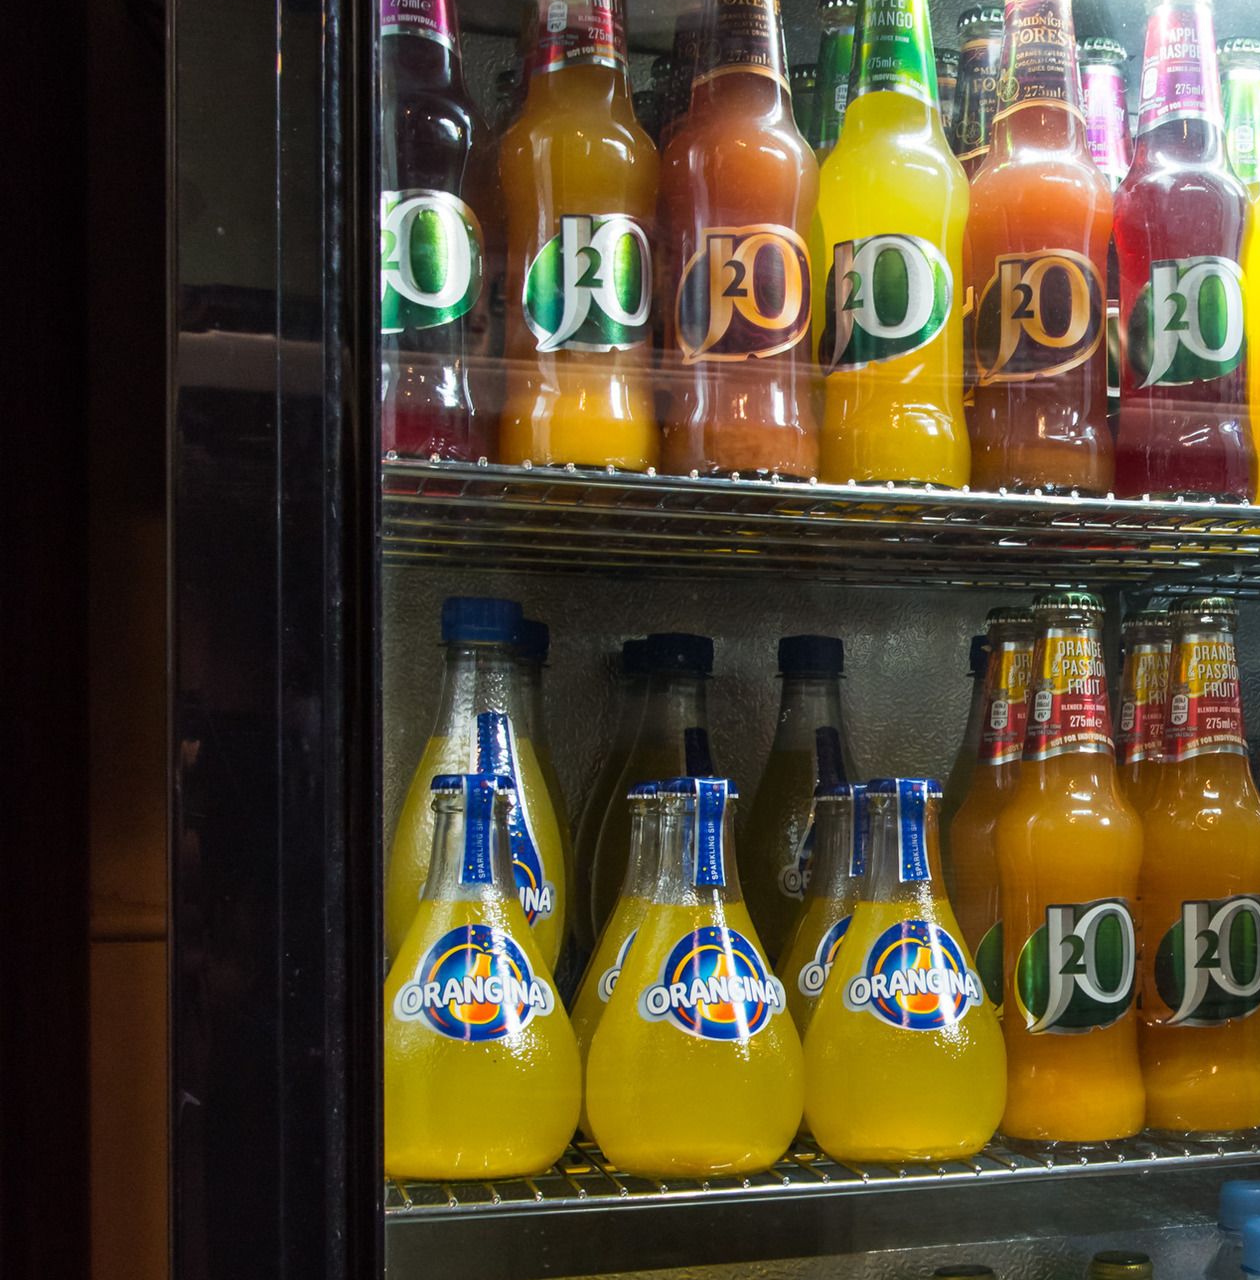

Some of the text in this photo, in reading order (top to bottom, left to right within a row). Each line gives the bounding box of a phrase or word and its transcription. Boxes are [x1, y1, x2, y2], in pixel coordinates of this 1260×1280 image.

[1057, 640, 1101, 658] ORANGE
[1140, 655, 1170, 670] ORAN
[1193, 645, 1236, 662] ORANGE
[1063, 659, 1105, 678] PASSION
[1068, 679, 1101, 695] FRUIT
[1203, 682, 1236, 698] FRUIT
[476, 833, 486, 879] SPARKLING
[707, 835, 719, 881] SPARKLING
[911, 833, 923, 877] SPARKLING
[400, 976, 547, 1015] ORANGINA
[646, 975, 781, 1016] ORANGINA
[849, 968, 980, 1006] ORANGINA
